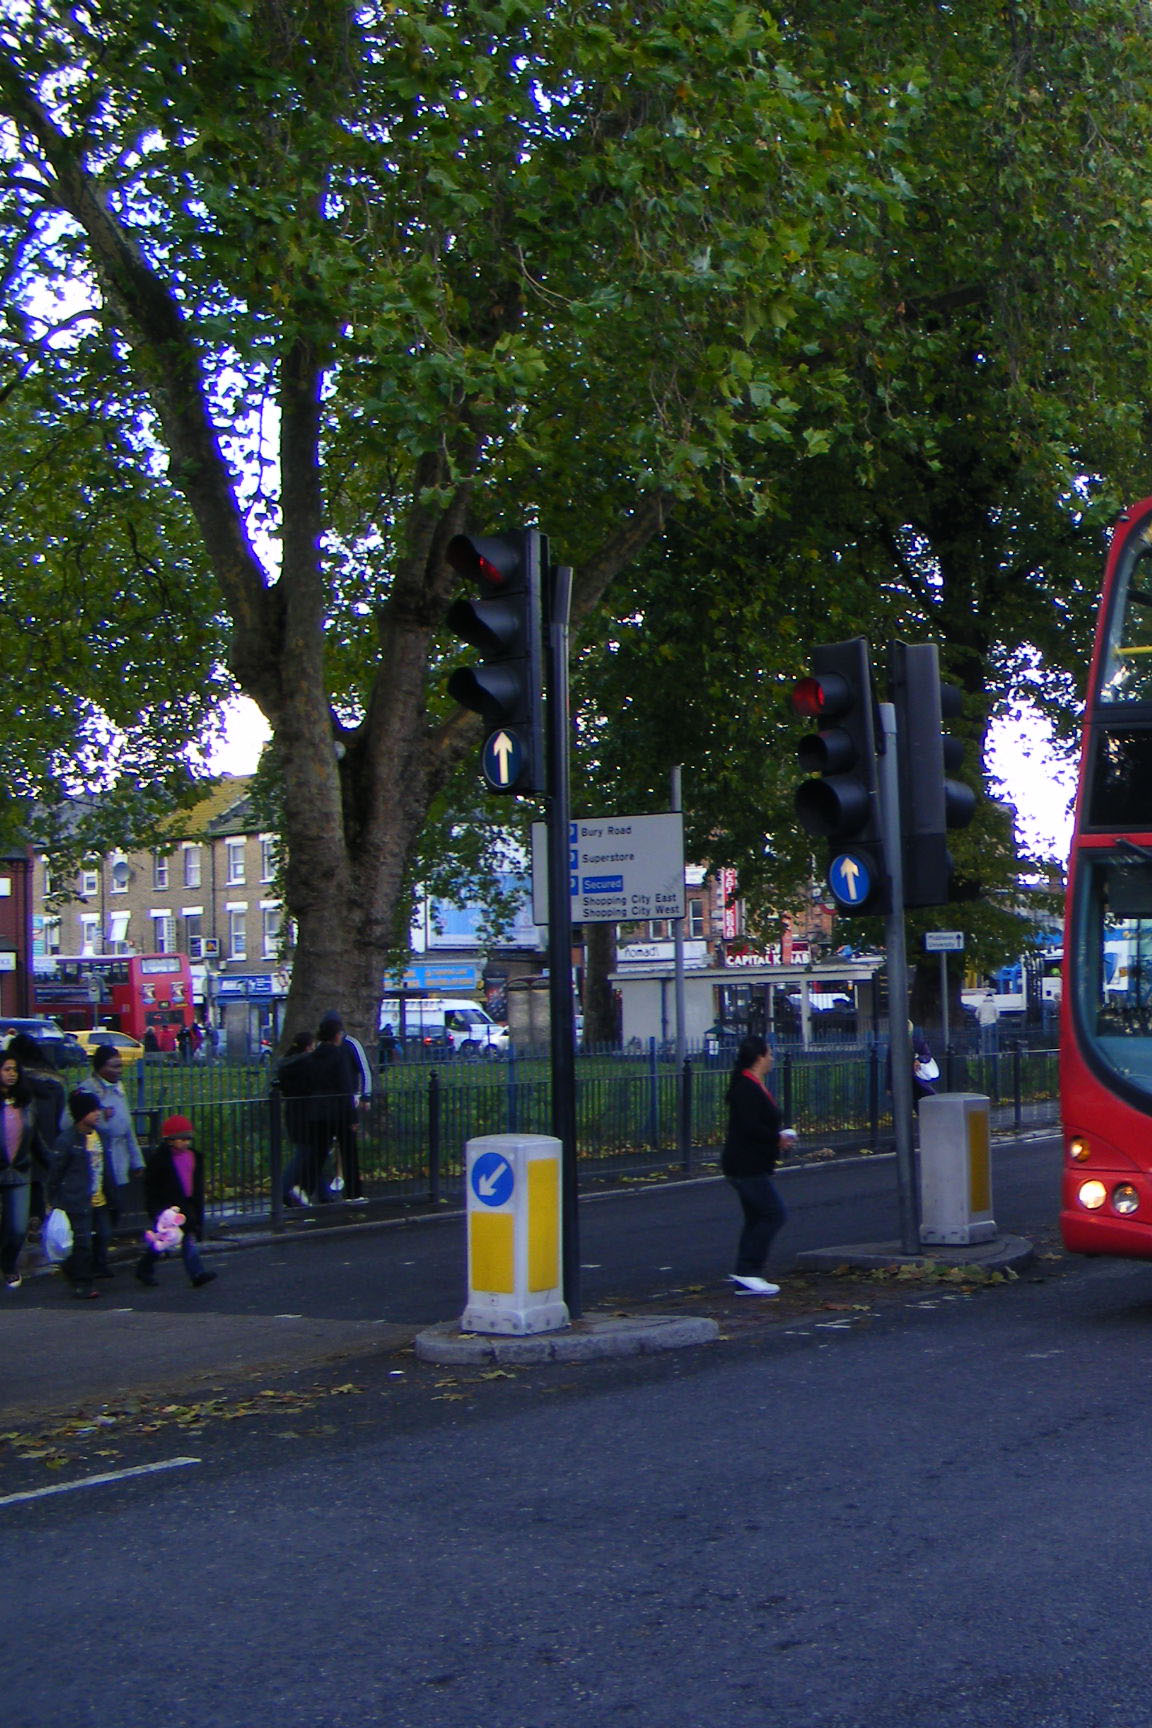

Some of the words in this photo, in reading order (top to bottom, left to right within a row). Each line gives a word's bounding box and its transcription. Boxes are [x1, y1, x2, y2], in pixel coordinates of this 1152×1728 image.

[581, 828, 602, 837] Bury
[607, 826, 632, 835] Road
[582, 853, 634, 864] Superstore
[584, 880, 621, 890] Secured
[583, 896, 627, 906] Shopping
[631, 894, 650, 904] City
[655, 893, 676, 903] East
[583, 908, 627, 918] Shopping
[631, 906, 650, 916] City
[655, 905, 680, 914] West
[726, 955, 771, 966] CAPITAL
